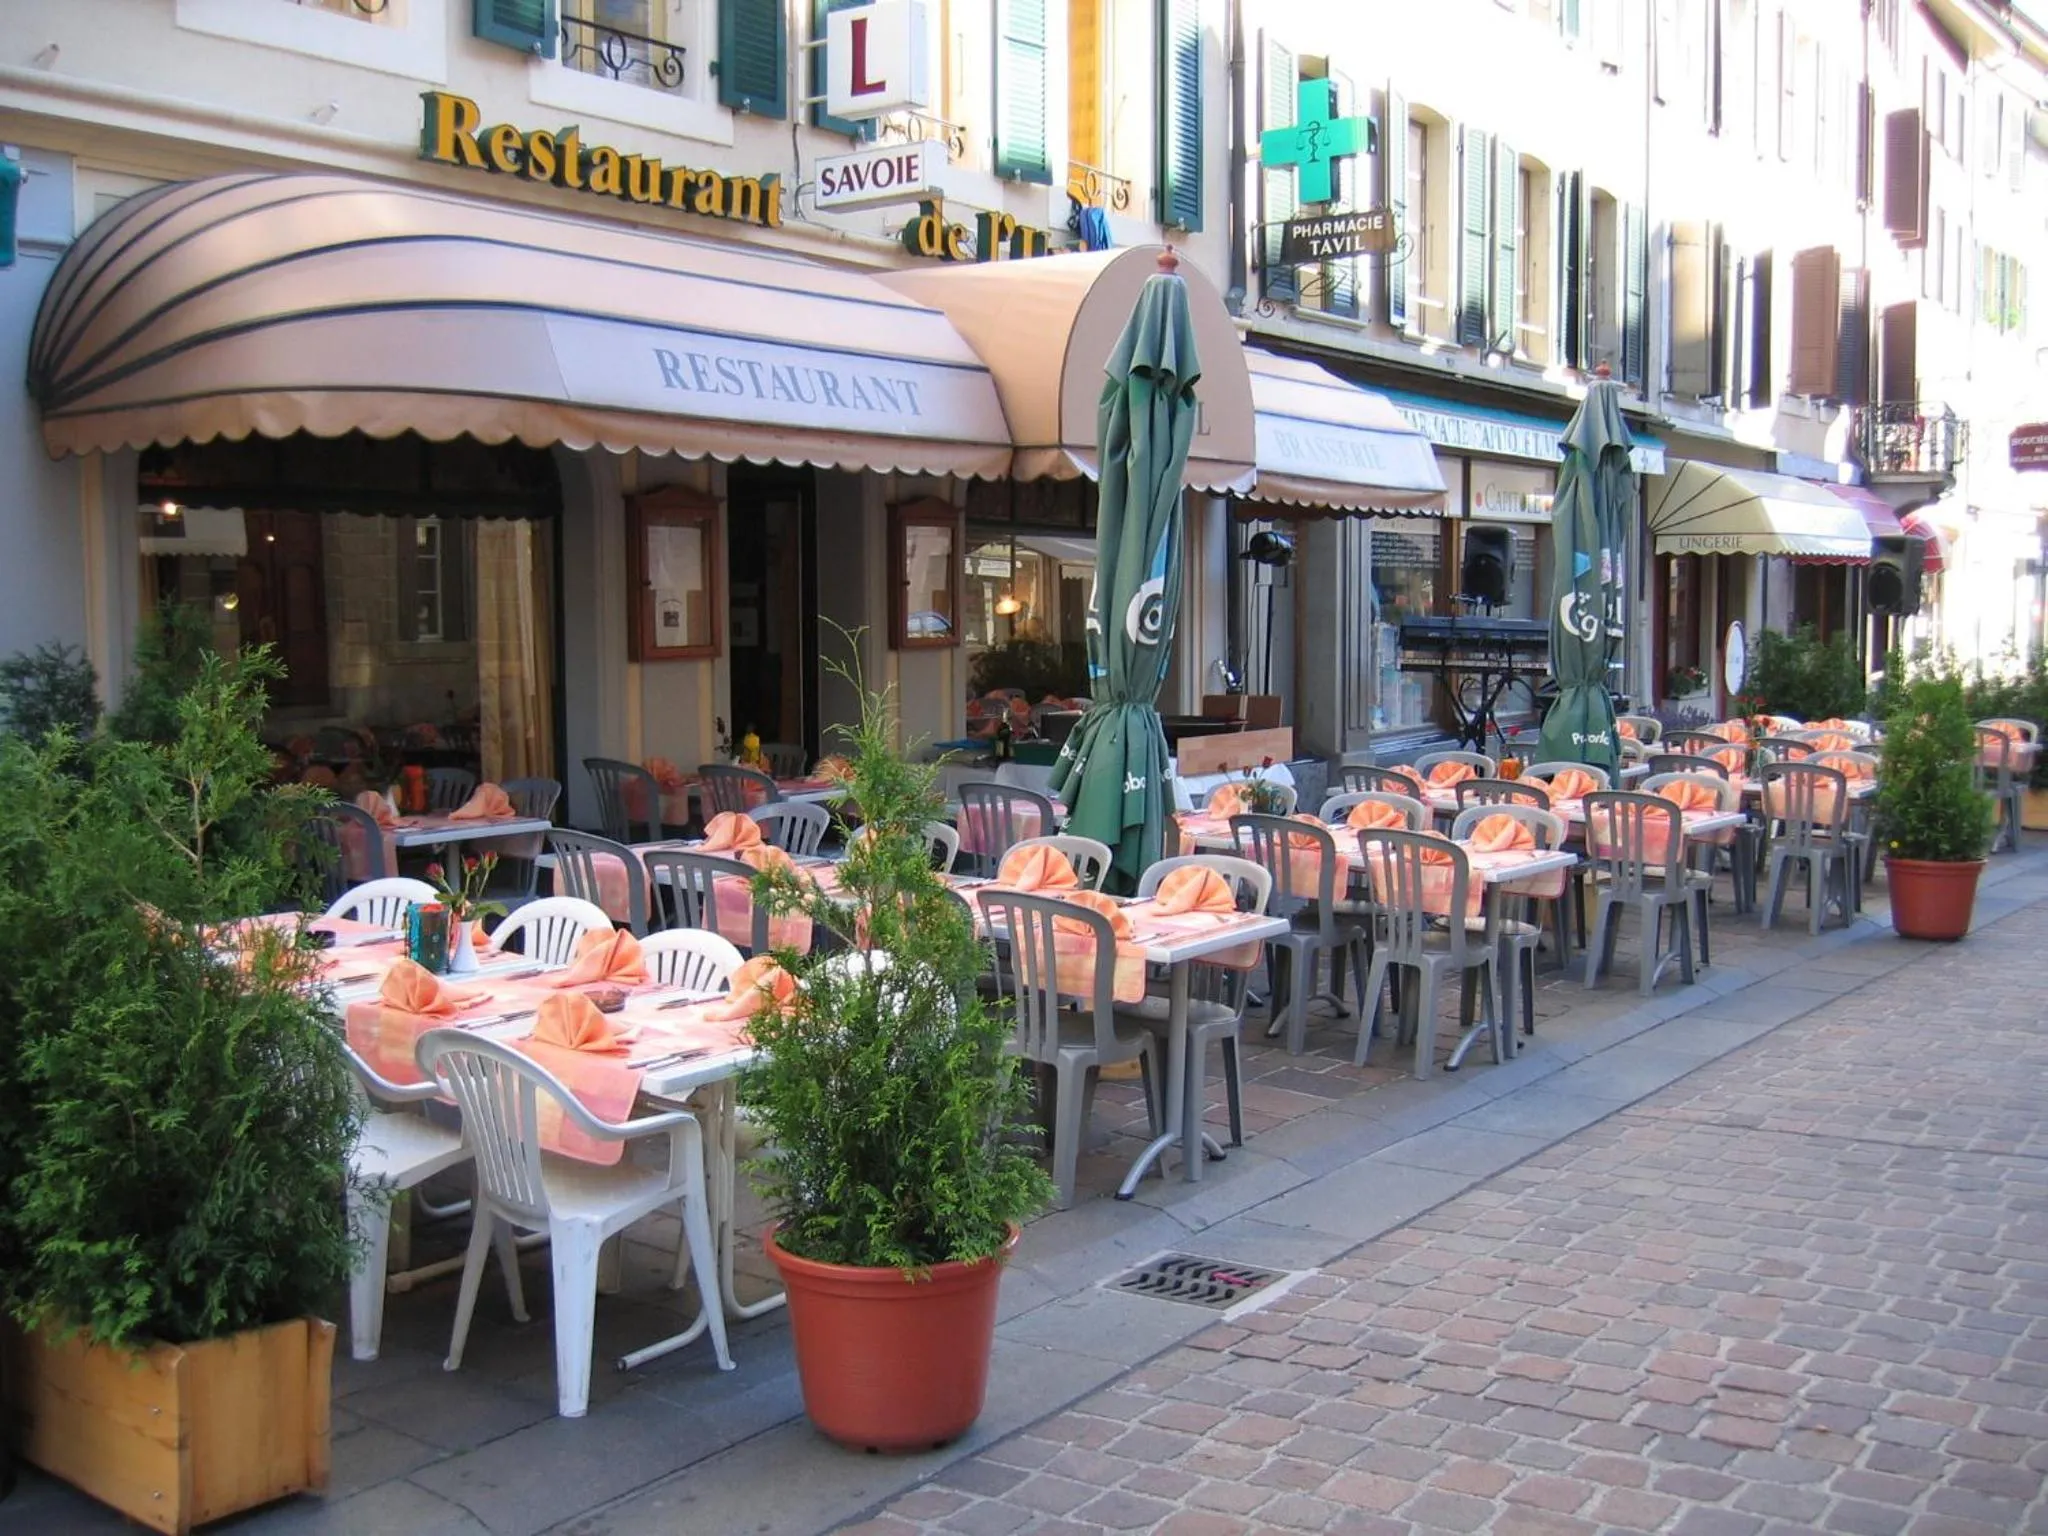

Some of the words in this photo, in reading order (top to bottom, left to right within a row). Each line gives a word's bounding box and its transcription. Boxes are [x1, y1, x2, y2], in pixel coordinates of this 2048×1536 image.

[851, 18, 886, 97] L
[420, 91, 784, 228] Restaurant
[905, 197, 970, 262] de
[821, 153, 920, 198] SAVOIE
[1292, 215, 1384, 239] PHARMACIE
[1309, 235, 1365, 256] TAVIL
[653, 348, 922, 416] RESTAURANT
[1272, 429, 1387, 470] BRASSERIE
[1680, 536, 1743, 549] LINGERIE
